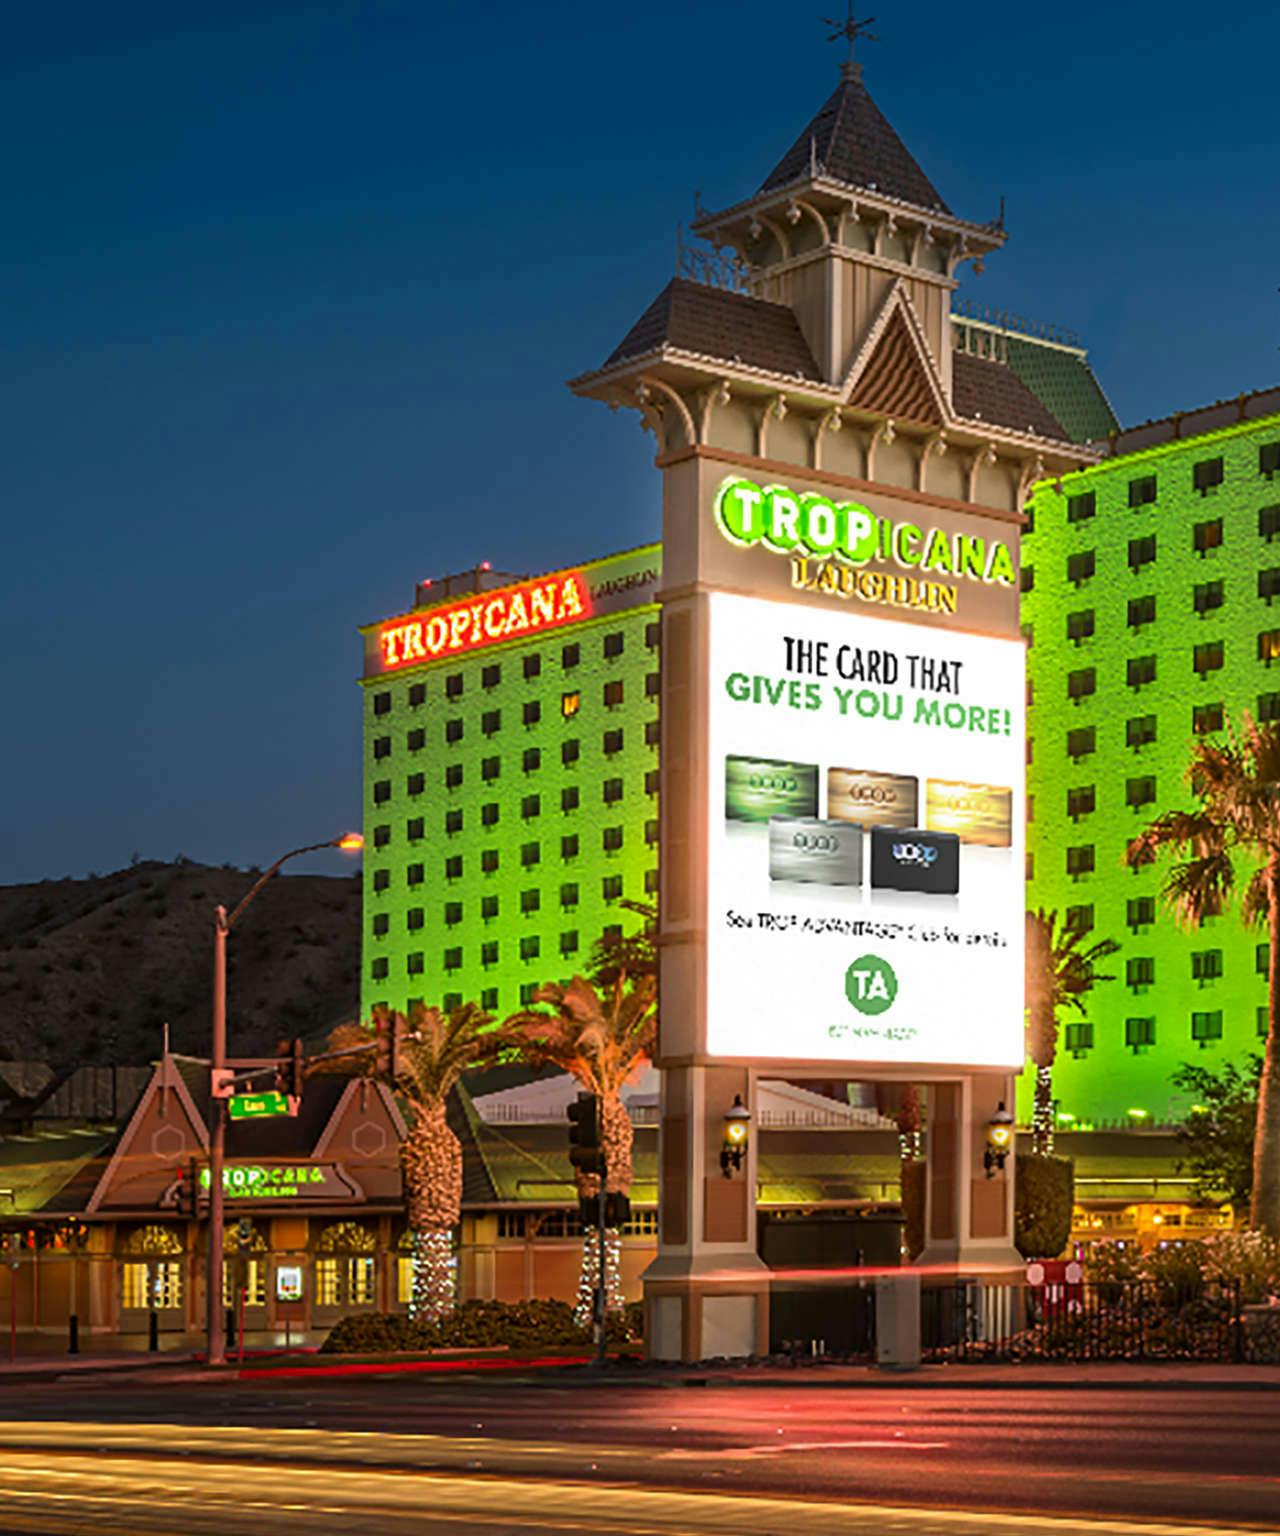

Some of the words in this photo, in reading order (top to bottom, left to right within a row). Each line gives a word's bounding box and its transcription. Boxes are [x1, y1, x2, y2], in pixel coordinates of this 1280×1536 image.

[714, 475, 1017, 587] TROPICANA
[791, 556, 959, 614] LAUGHLIN
[380, 576, 583, 666] TROPICANA
[783, 636, 829, 676] THE
[835, 644, 899, 684] CARD
[905, 655, 964, 695] THAT
[725, 672, 823, 711] GIVES
[833, 685, 904, 721] YOU
[912, 697, 1012, 736] MORE!
[852, 969, 891, 1001] TA
